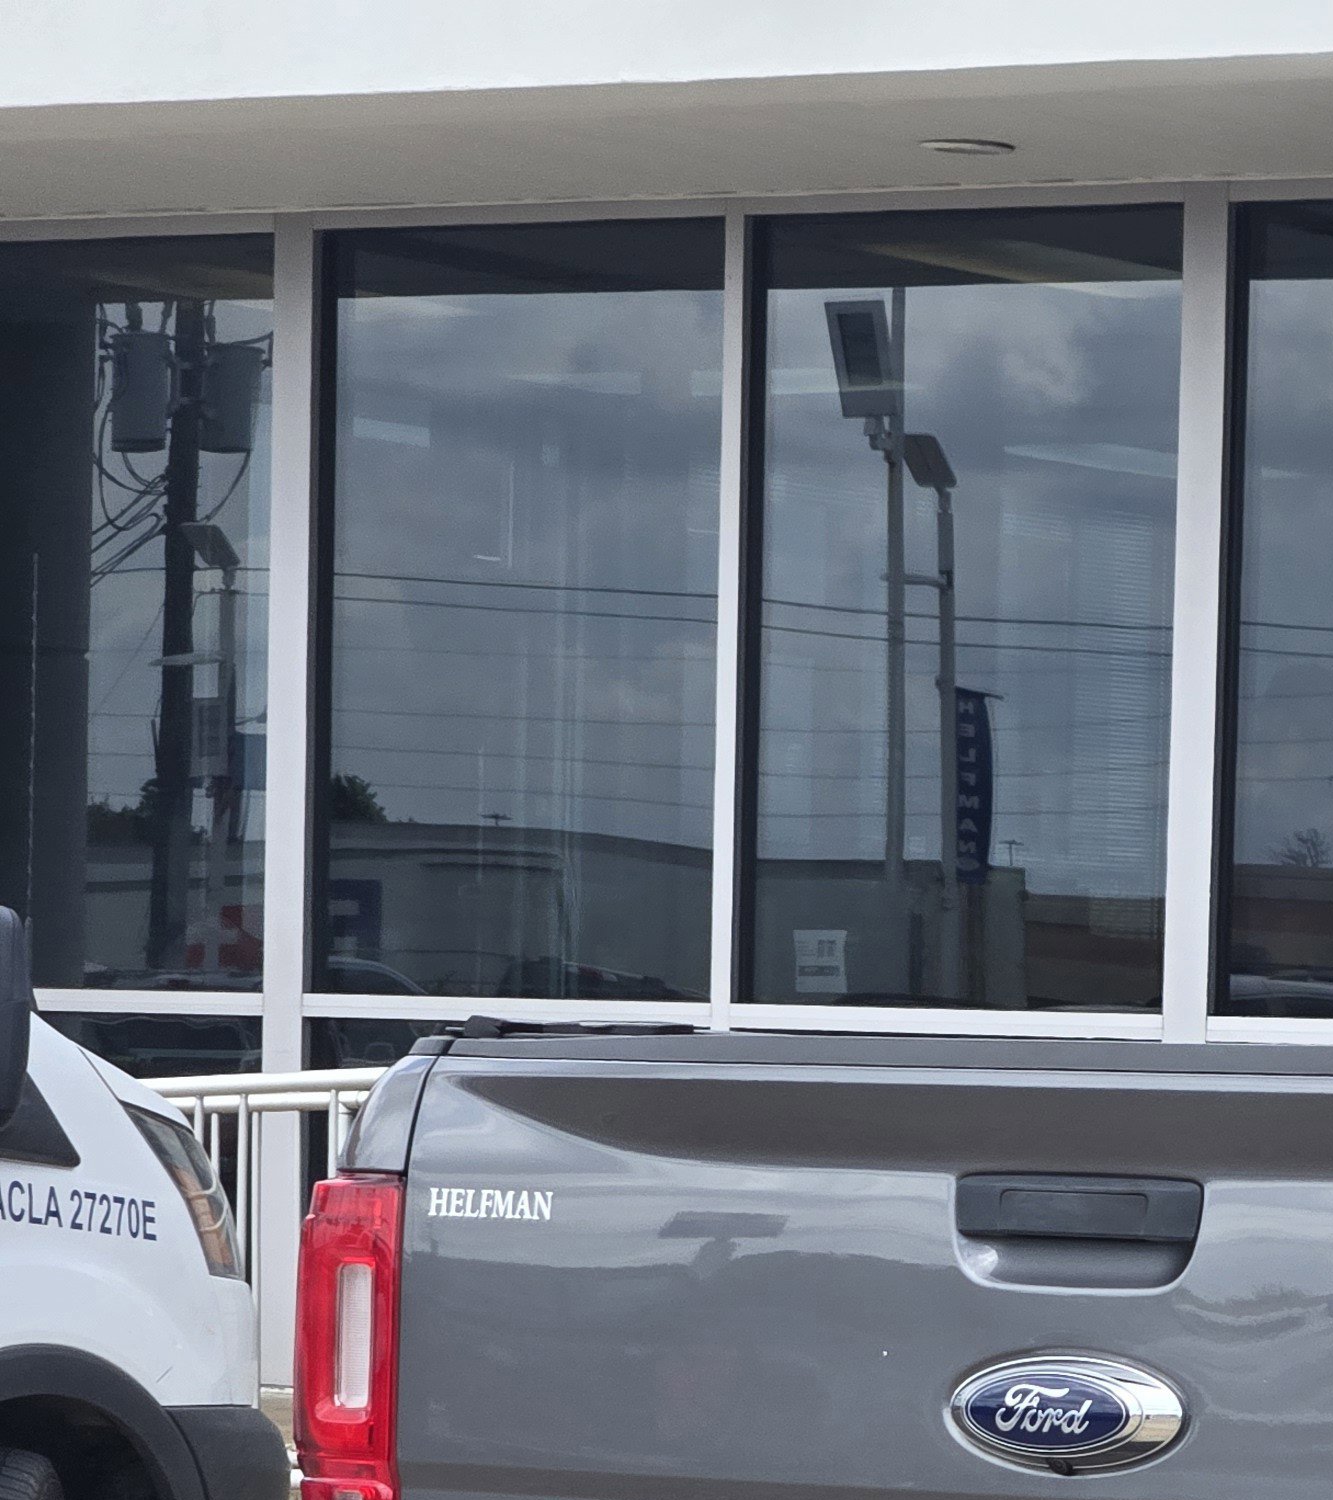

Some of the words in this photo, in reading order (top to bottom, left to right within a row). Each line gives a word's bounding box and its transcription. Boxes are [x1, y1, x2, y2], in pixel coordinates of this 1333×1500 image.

[69, 1189, 157, 1241] 27270E
[428, 1187, 554, 1222] HELFMAN
[995, 1383, 1093, 1435] Ford
